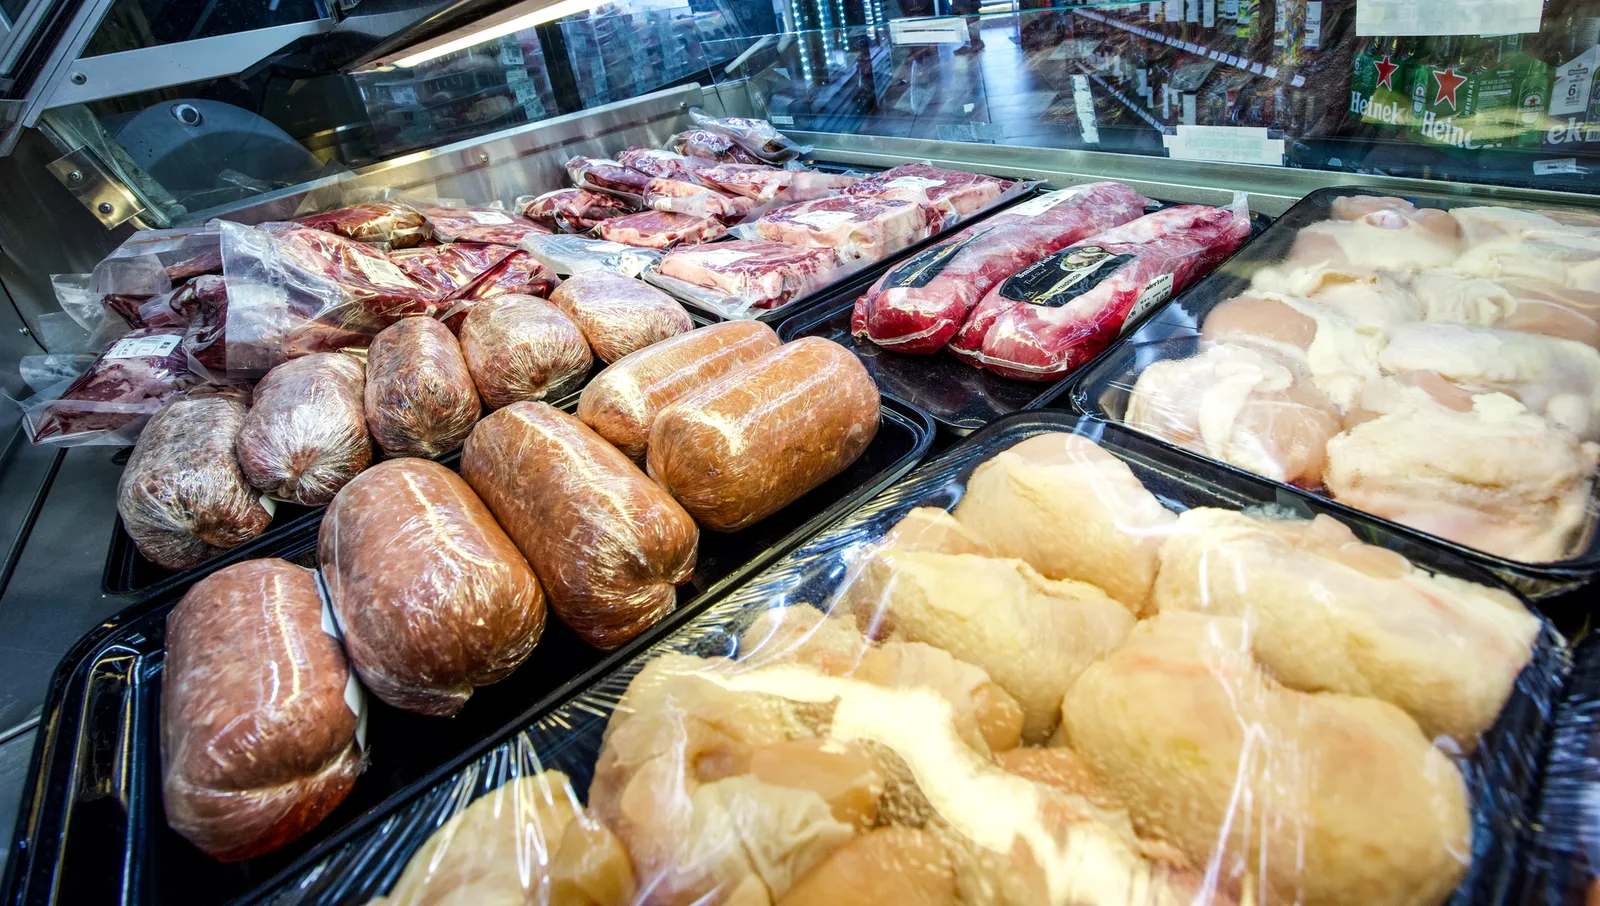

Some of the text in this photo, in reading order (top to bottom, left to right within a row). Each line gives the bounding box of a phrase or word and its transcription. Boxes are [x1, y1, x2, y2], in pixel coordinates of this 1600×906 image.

[1464, 79, 1475, 115] ORIGINAL
[1568, 84, 1577, 97] 6
[1015, 254, 1058, 279] Smithfield
[1057, 272, 1082, 292] TENDERLOIN
